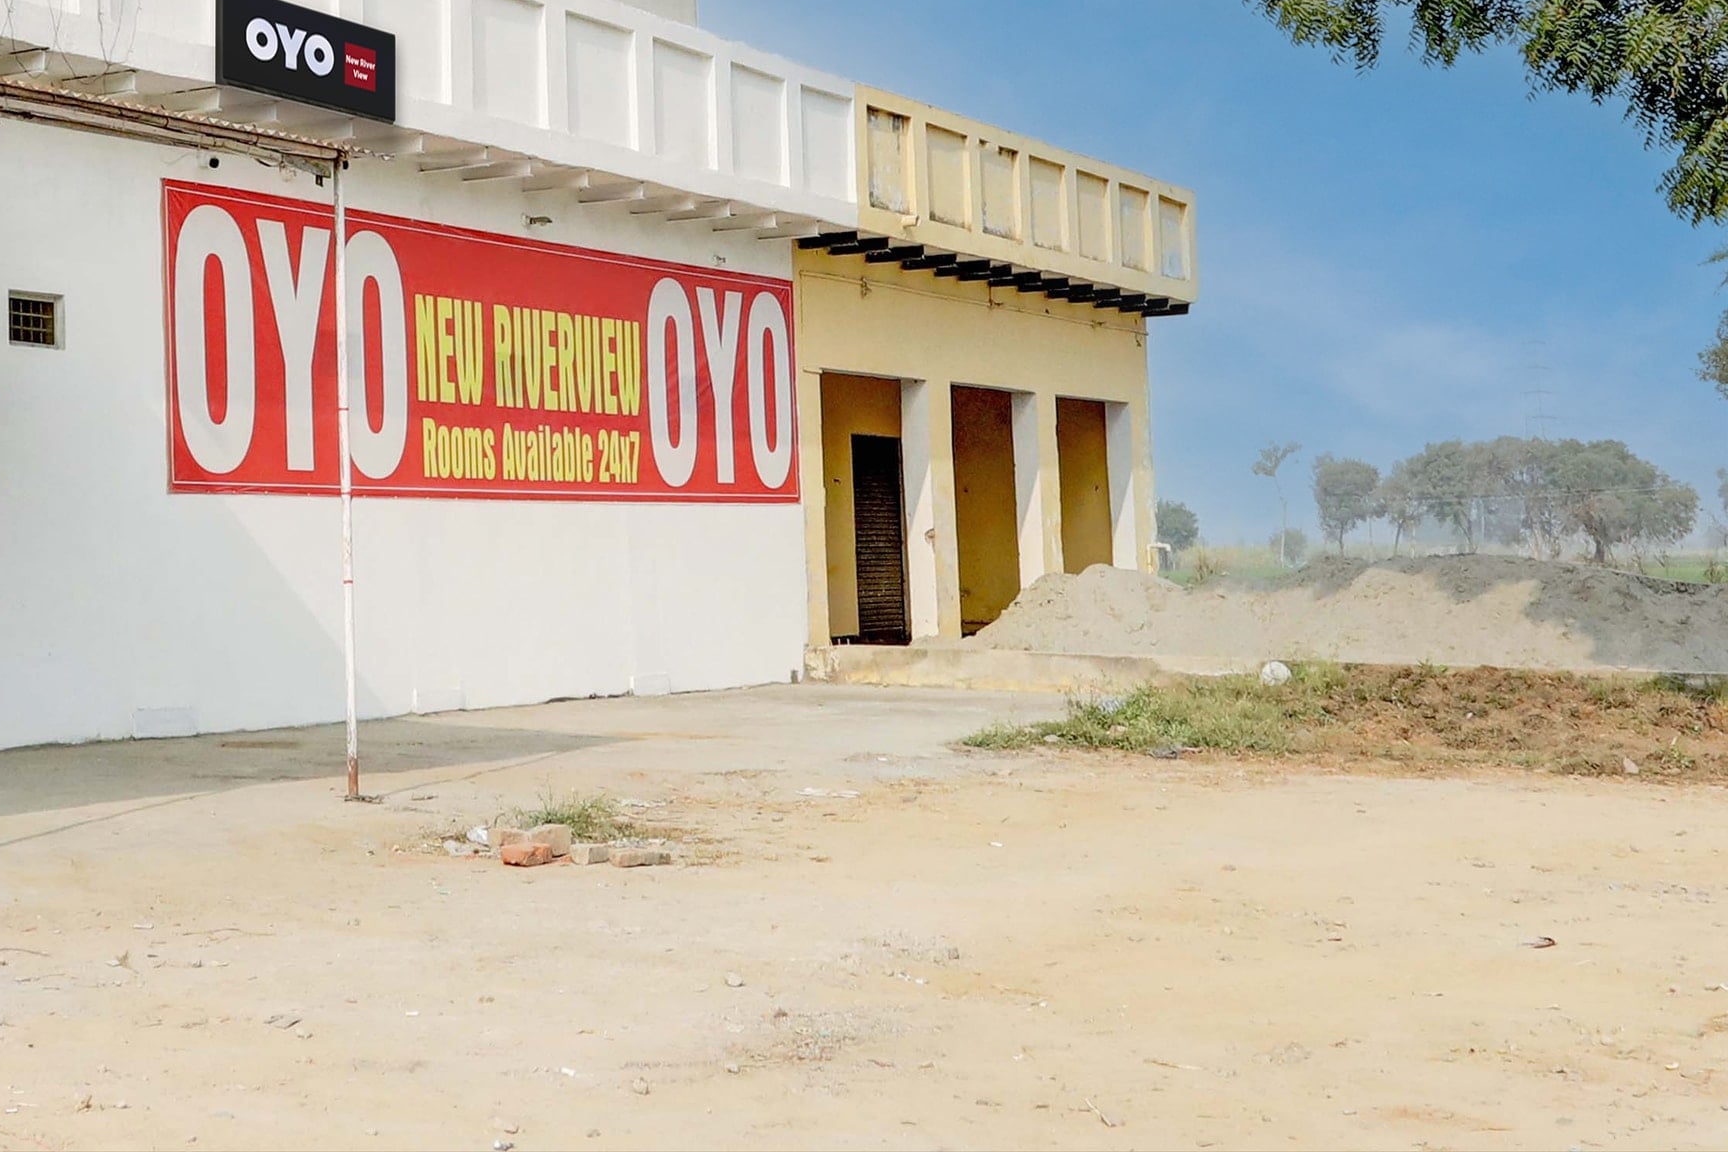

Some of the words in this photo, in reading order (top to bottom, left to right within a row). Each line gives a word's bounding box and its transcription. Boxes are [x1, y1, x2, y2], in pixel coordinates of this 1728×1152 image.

[245, 17, 334, 76] OYO
[346, 54, 359, 66] New
[360, 58, 376, 70] River
[353, 69, 368, 80] View
[174, 204, 409, 479] OYO
[414, 294, 483, 405] NEW
[493, 304, 641, 416] RIVERVIEW
[647, 277, 793, 489] OYO
[423, 417, 496, 480] Rooms
[503, 423, 594, 483] Available
[598, 429, 641, 484] 24x7
